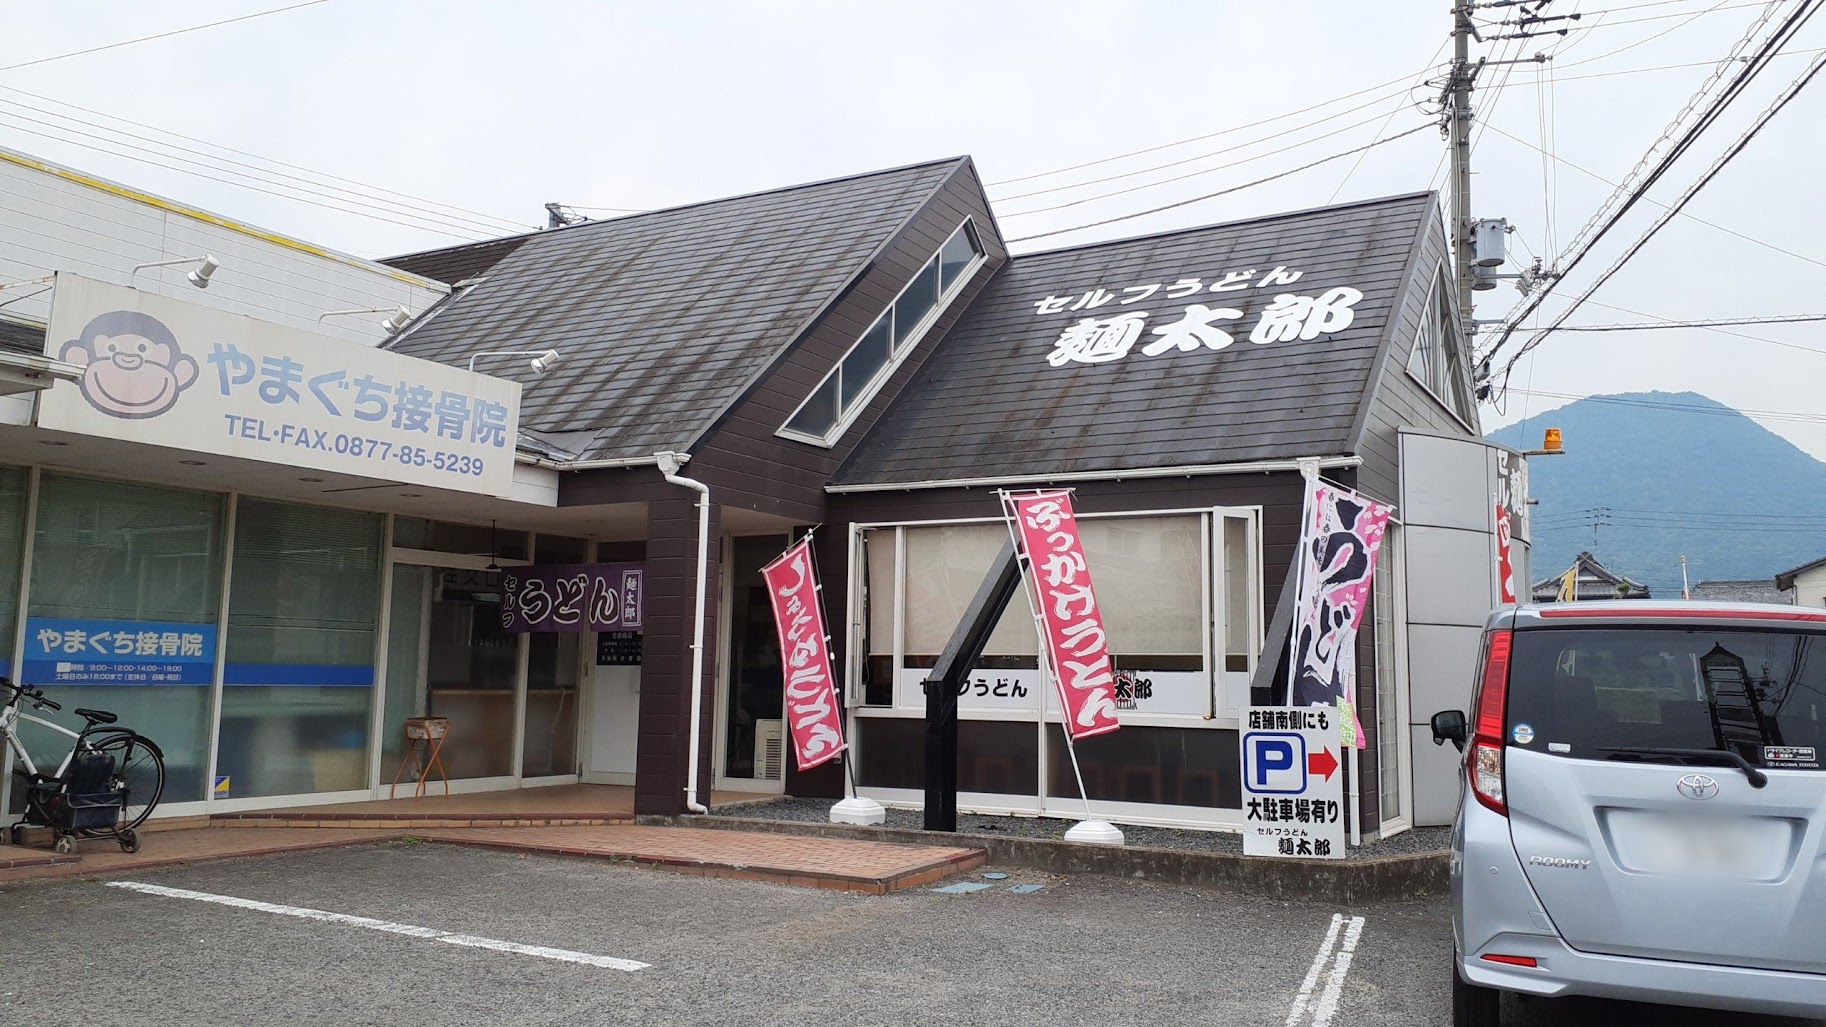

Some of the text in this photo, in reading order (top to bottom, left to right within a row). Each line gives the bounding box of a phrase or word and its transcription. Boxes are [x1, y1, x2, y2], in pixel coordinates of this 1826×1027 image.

[1034, 266, 1304, 315] セルフうどん
[207, 341, 508, 448] やまぐち接骨院
[503, 575, 518, 628] セルフ
[518, 573, 619, 624] うどん
[1026, 498, 1118, 727] ぶっかけうどん
[37, 628, 204, 657] やまぐち接骨院
[919, 677, 1029, 699] フうどん
[1113, 678, 1153, 700] 太郎
[1248, 710, 1330, 730] 店舗南側にも
[1255, 740, 1293, 785] P
[1246, 797, 1339, 824] 大駐車場有り
[1256, 827, 1309, 837] セルフうどん
[1529, 855, 1592, 870] ROOMY
